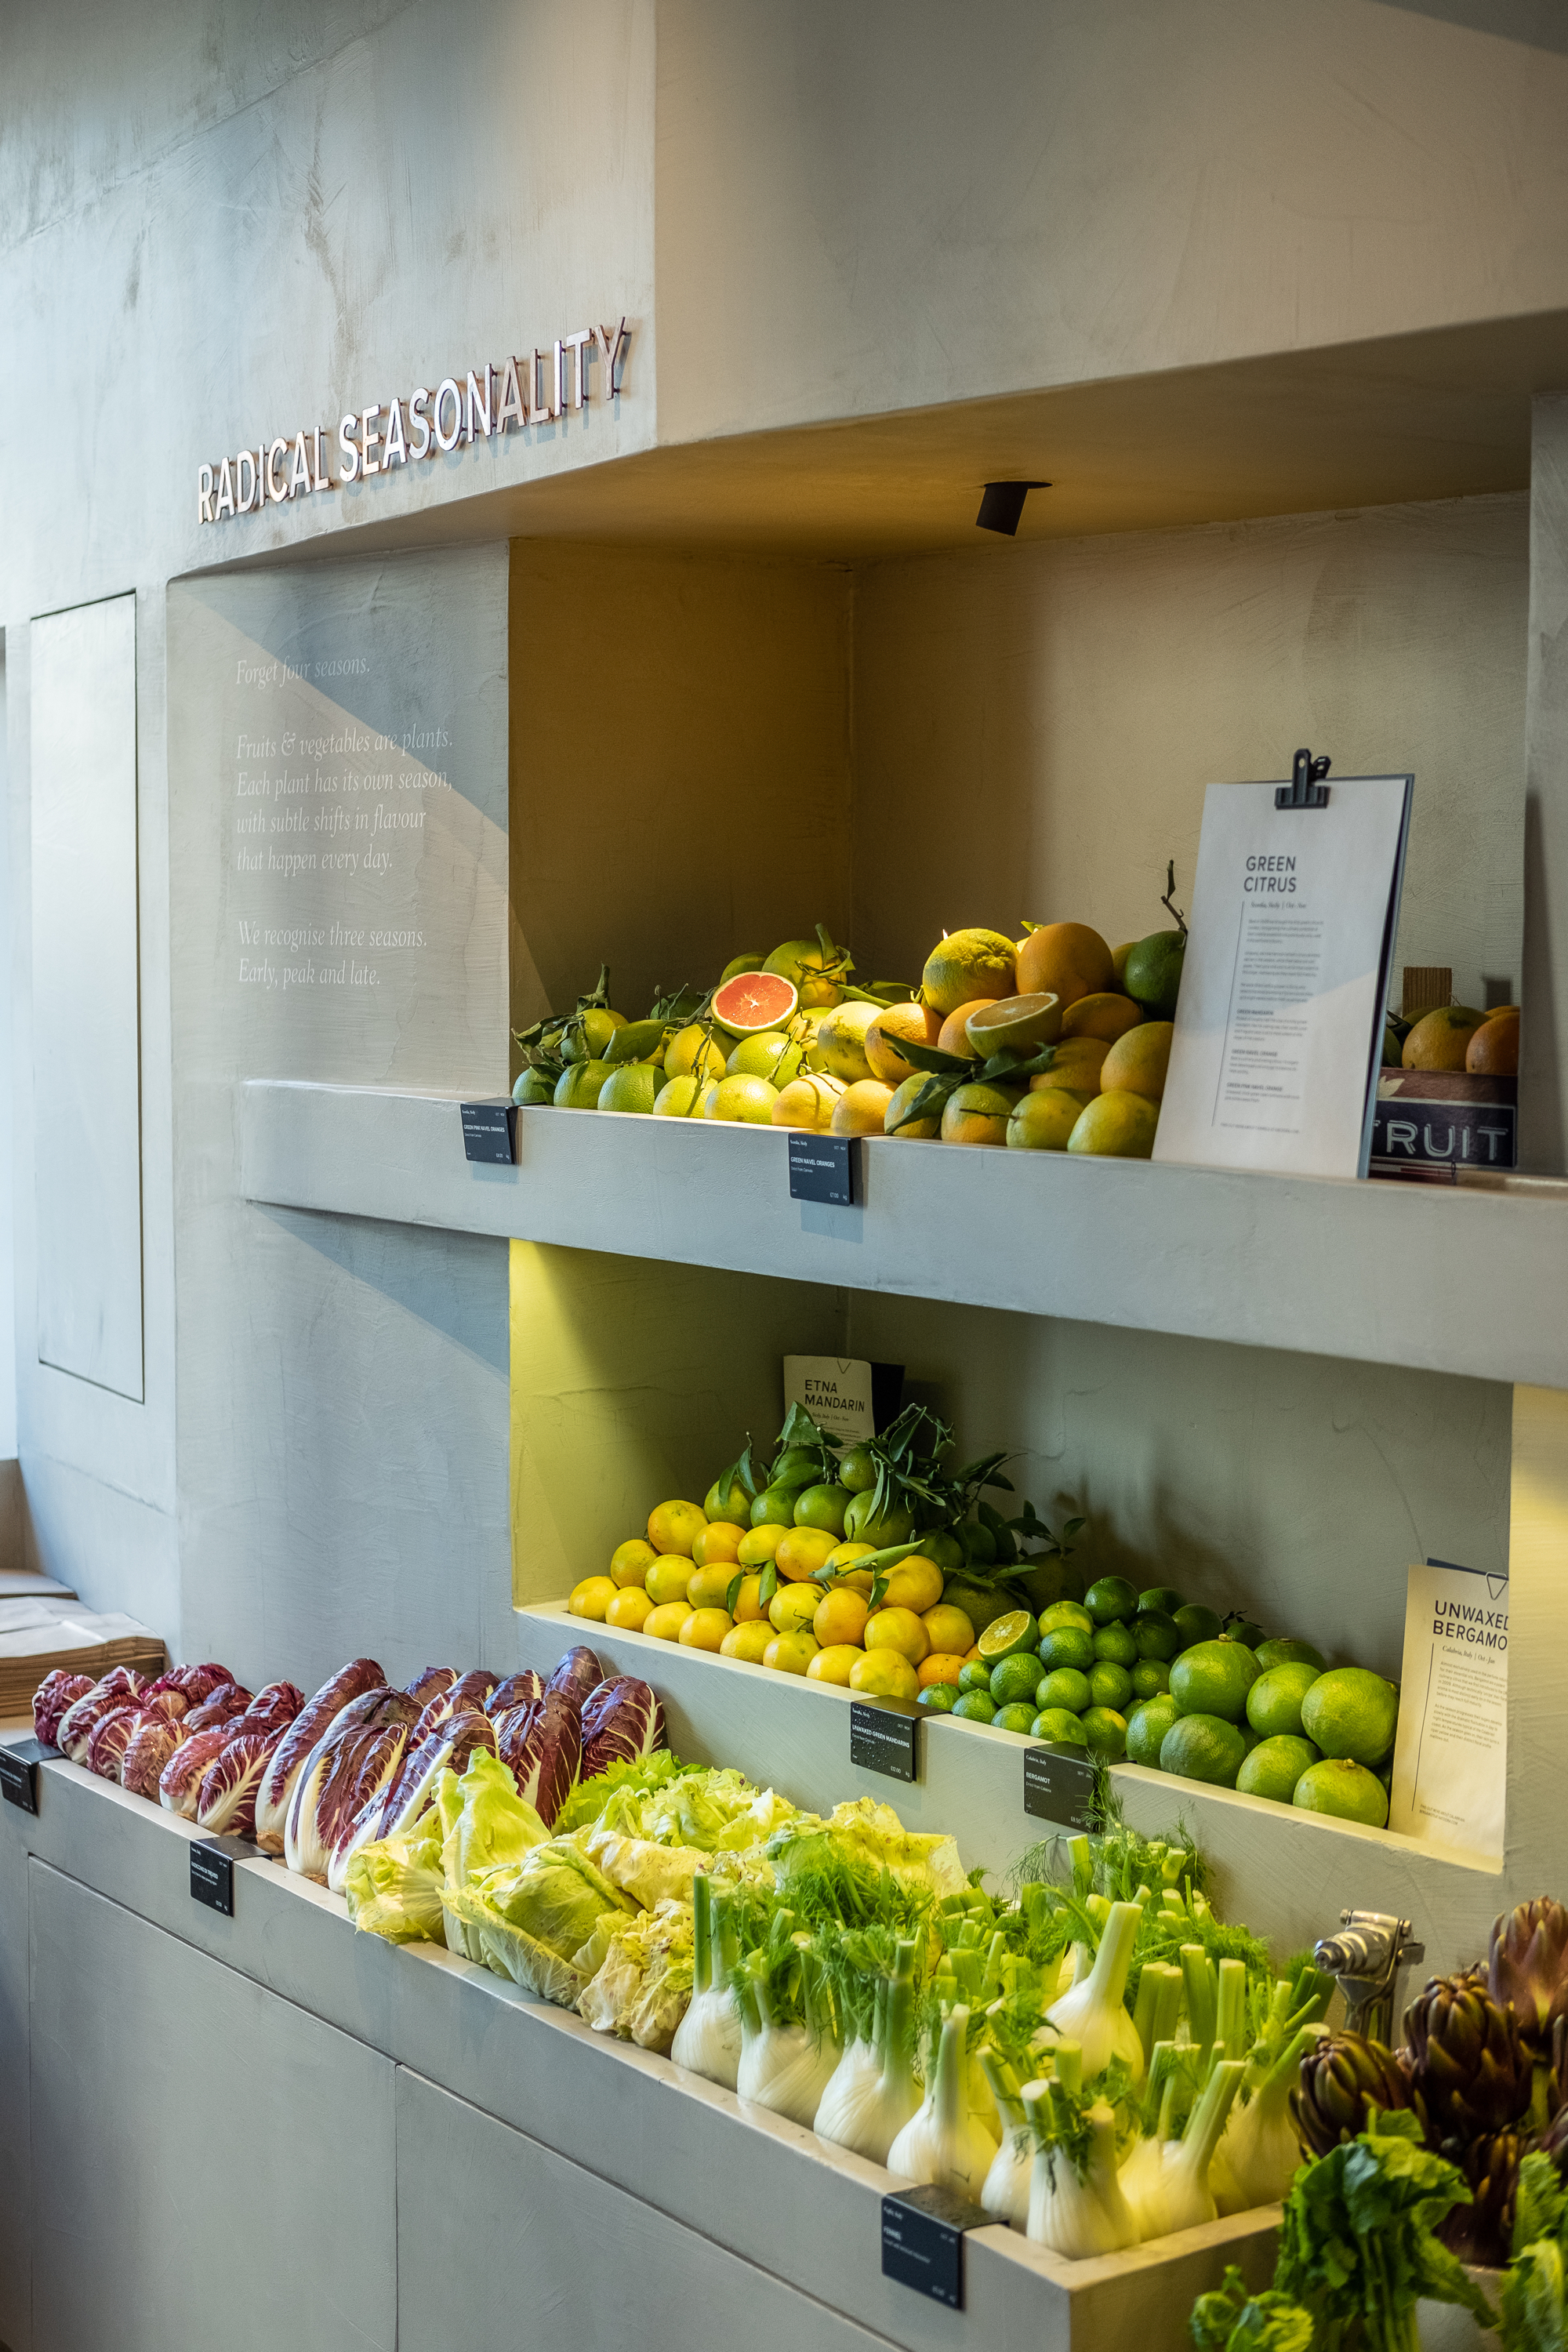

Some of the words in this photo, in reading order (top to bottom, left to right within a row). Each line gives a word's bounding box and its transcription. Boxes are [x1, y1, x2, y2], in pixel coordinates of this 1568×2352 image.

[197, 426, 332, 525] RADICAL
[339, 316, 626, 483] SEASONALITY
[236, 660, 277, 689] Forget
[280, 656, 310, 687] four
[315, 657, 370, 677] seasons.
[237, 734, 276, 758] Fruits
[281, 732, 296, 755] &
[300, 728, 370, 761] vegetables
[375, 732, 397, 750] are
[401, 723, 453, 756] plants.
[237, 771, 270, 796] Each
[275, 772, 310, 801] plant
[315, 768, 337, 792] has
[342, 768, 359, 791] its
[364, 773, 393, 791] own
[398, 770, 453, 792] season,
[237, 810, 265, 833] with
[270, 806, 309, 832] subtle
[314, 805, 350, 837] shifts
[355, 806, 368, 829] in
[371, 804, 426, 836] flavour
[237, 847, 263, 870] that
[268, 846, 316, 876] happen
[322, 851, 359, 875] every
[363, 844, 392, 875] day.
[1246, 856, 1296, 871] GREEN
[1244, 876, 1296, 892] CITRUS
[239, 921, 260, 945] We
[265, 923, 325, 952] recognise
[330, 921, 365, 946] three
[370, 929, 427, 947] seasons.
[239, 957, 278, 989] Early,
[283, 959, 314, 989] peak
[319, 960, 346, 984] and
[351, 960, 380, 985] late.
[1373, 1120, 1508, 1160] RUIT
[805, 1380, 837, 1393] ETNA
[805, 1394, 864, 1412] MANDARIN
[1442, 1645, 1462, 1656] Calabria,
[1463, 1651, 1472, 1659] Italy
[872, 1731, 885, 1740] GREEN
[1026, 1772, 1050, 1784] BERGAMOT
